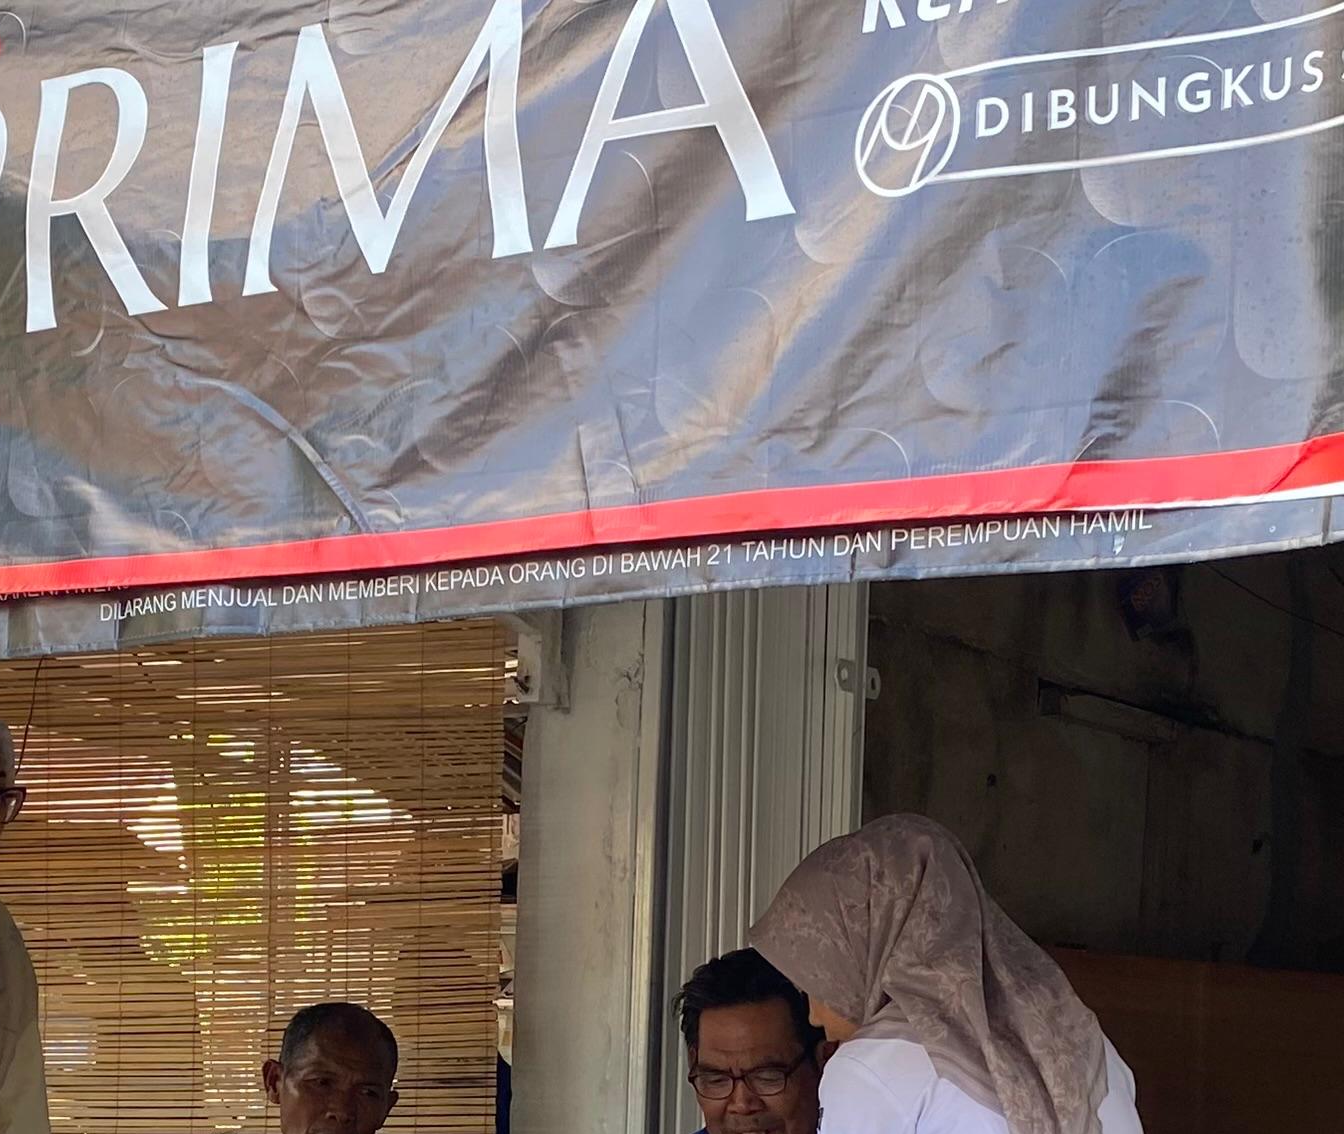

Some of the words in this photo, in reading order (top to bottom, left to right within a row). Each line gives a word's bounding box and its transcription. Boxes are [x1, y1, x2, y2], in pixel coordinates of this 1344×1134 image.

[974, 49, 1324, 139] DIBUNGKUS
[100, 592, 177, 622] DILARANG
[181, 587, 278, 611] MENJUAL
[282, 582, 324, 606] DAN
[328, 572, 420, 603] MEMBERI
[424, 565, 505, 594] KEPADA
[508, 558, 586, 586] ORANG
[592, 554, 613, 577] DI
[620, 546, 702, 574] BAWAH
[706, 543, 733, 567] 21
[742, 535, 827, 563] TAHUN
[832, 531, 883, 559] DAN
[891, 515, 1061, 553] PEREMPUAN
[1070, 507, 1154, 537] HAMIL
